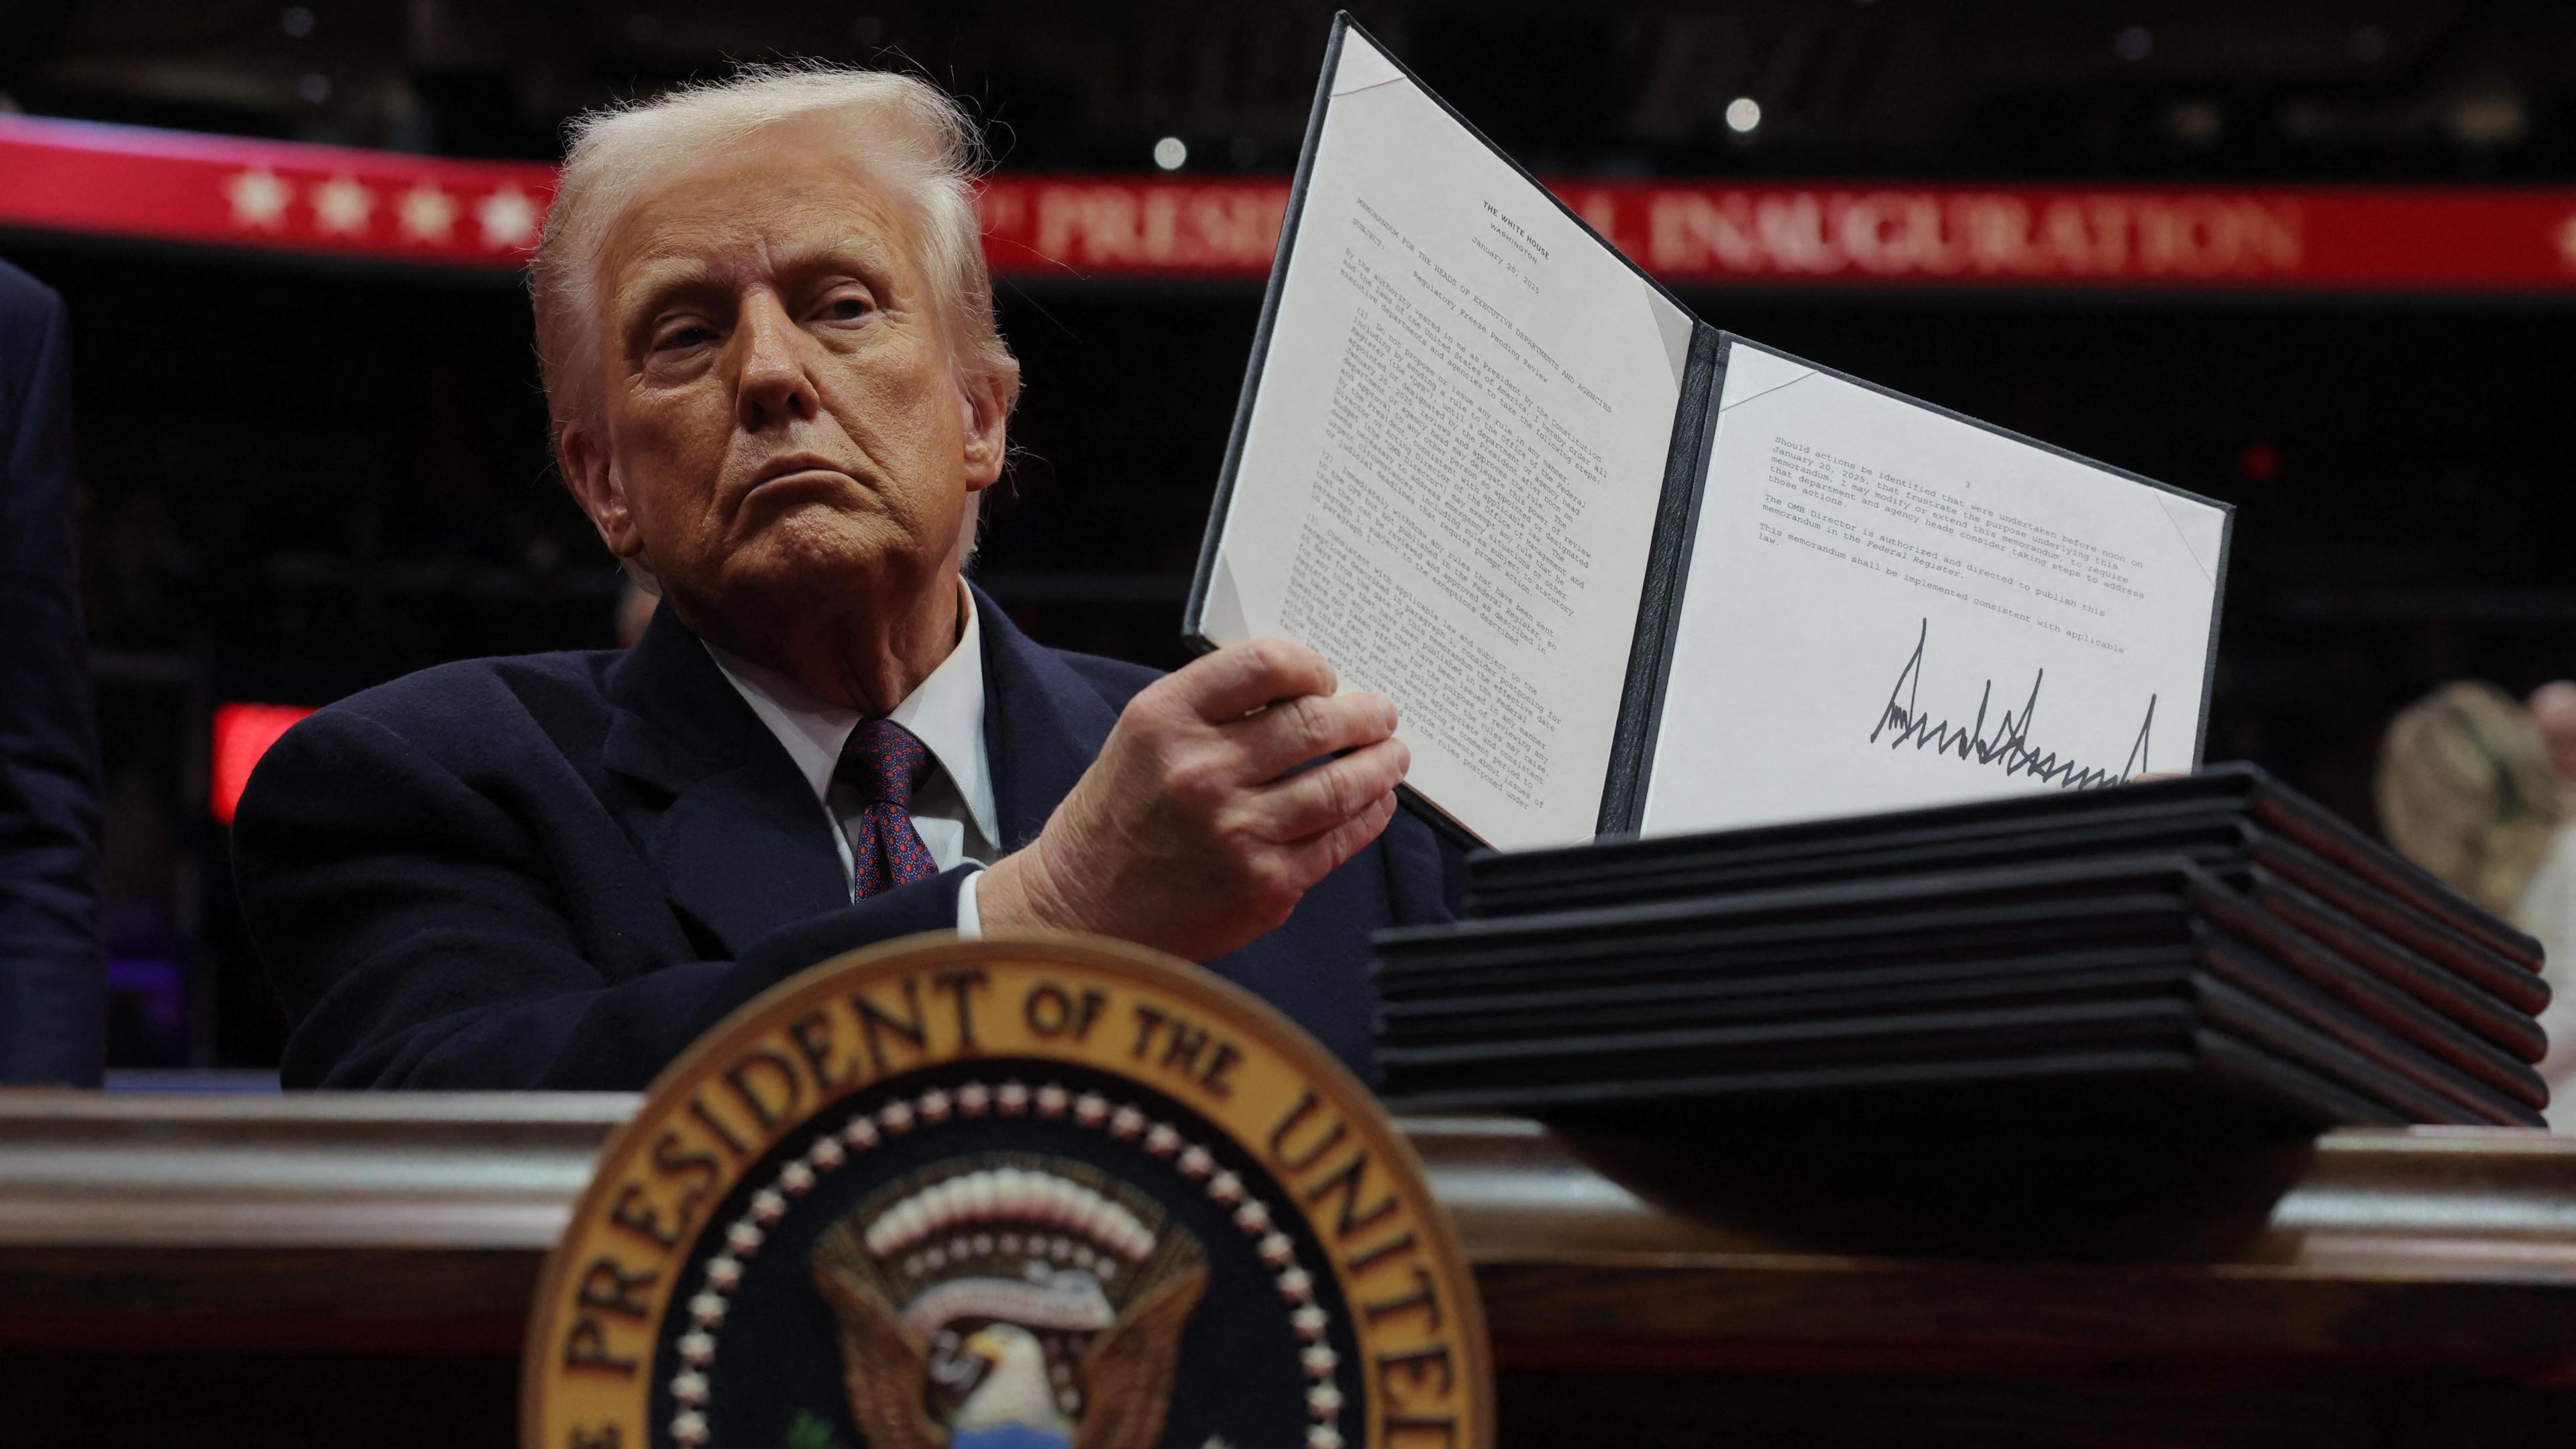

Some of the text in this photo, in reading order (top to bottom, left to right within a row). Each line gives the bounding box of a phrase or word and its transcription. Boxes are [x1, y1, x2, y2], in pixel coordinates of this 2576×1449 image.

[1472, 237, 1540, 294] January 20, 2025
[1483, 201, 1550, 260] THE WHITE HOUSE
[1491, 223, 1538, 264] WASHINGTON
[1650, 188, 2300, 270] INAUGURATION
[1346, 247, 1601, 464] By the authority vested in me as President by the Constitution
[1357, 198, 1611, 413] MEMORANDUM FOR THE HEADS OF EXECUTIVE DEPARTMENTS AND AGENCIES
[1413, 271, 1456, 312] Regulatory
[1461, 308, 1486, 333] Freeze
[1491, 331, 1520, 362] Pending
[1523, 358, 1548, 384] Review
[1340, 270, 1599, 484] executive departments and agencies to take the following steps:
[1342, 259, 1356, 273] and
[1359, 272, 1373, 288] the
[1375, 286, 1393, 306] laws
[1396, 305, 1405, 315] of
[1408, 315, 1421, 330] the
[1425, 328, 1451, 354] United
[1455, 352, 1481, 377] States
[1485, 376, 1494, 386] of
[1497, 384, 1528, 415] America,
[1542, 422, 1566, 449] hereby
[1570, 447, 1590, 466] order
[1595, 466, 1607, 478] all
[1354, 316, 1393, 354] including
[1394, 350, 1403, 364] by
[1407, 363, 1437, 392] sending
[1450, 396, 1466, 414] rule
[1471, 412, 1480, 423] to
[1485, 421, 1497, 436] the
[1501, 434, 1526, 459] Office
[1529, 460, 1538, 470] of
[1540, 468, 1553, 482] the
[1557, 481, 1586, 509] Federal
[1376, 323, 1385, 335] Do
[1389, 335, 1402, 349] not
[1405, 350, 1435, 377] propose
[1438, 376, 1448, 386] or
[1452, 385, 1473, 407] issue
[1478, 406, 1491, 421] any
[1495, 419, 1512, 436] rule
[1516, 435, 1525, 446] in
[1527, 446, 1540, 461] any
[1543, 460, 1570, 487] manner,
[1759, 533, 1780, 546] law.
[1763, 505, 1962, 578] memorandum in the Federal Register.
[1768, 476, 1846, 508] those actions.
[1770, 466, 2144, 599] that department and agency heads consider taking steps to address
[1772, 458, 1832, 483] memorandum,
[1852, 485, 1869, 496] may
[1875, 493, 1909, 510] modify
[1915, 506, 1927, 515] or
[1933, 513, 1968, 528] extend
[1974, 525, 1996, 538] this
[2002, 536, 2063, 562] memorandum,
[2072, 559, 2082, 568] to
[2088, 566, 2128, 584] require
[1773, 446, 2118, 570] January 20, 2025, that frustrate the purpose underlying this
[1775, 437, 1809, 453] Should
[1815, 452, 1855, 469] actions
[1862, 466, 1872, 475] be
[1879, 472, 1936, 496] identified
[1942, 494, 1965, 506] that
[1971, 505, 1993, 517] were
[1999, 515, 2056, 538] undertaken
[2062, 535, 2096, 552] before
[2102, 551, 2125, 562] noon
[1760, 523, 2124, 654] This memorandum shall be implemented consistent with applicable
[1764, 494, 2105, 616] The OMB Director is authorized and directed to publish this
[567, 969, 989, 1377] PRESIDENT
[1024, 985, 1108, 1040] OF
[1130, 1003, 1242, 1099] THE
